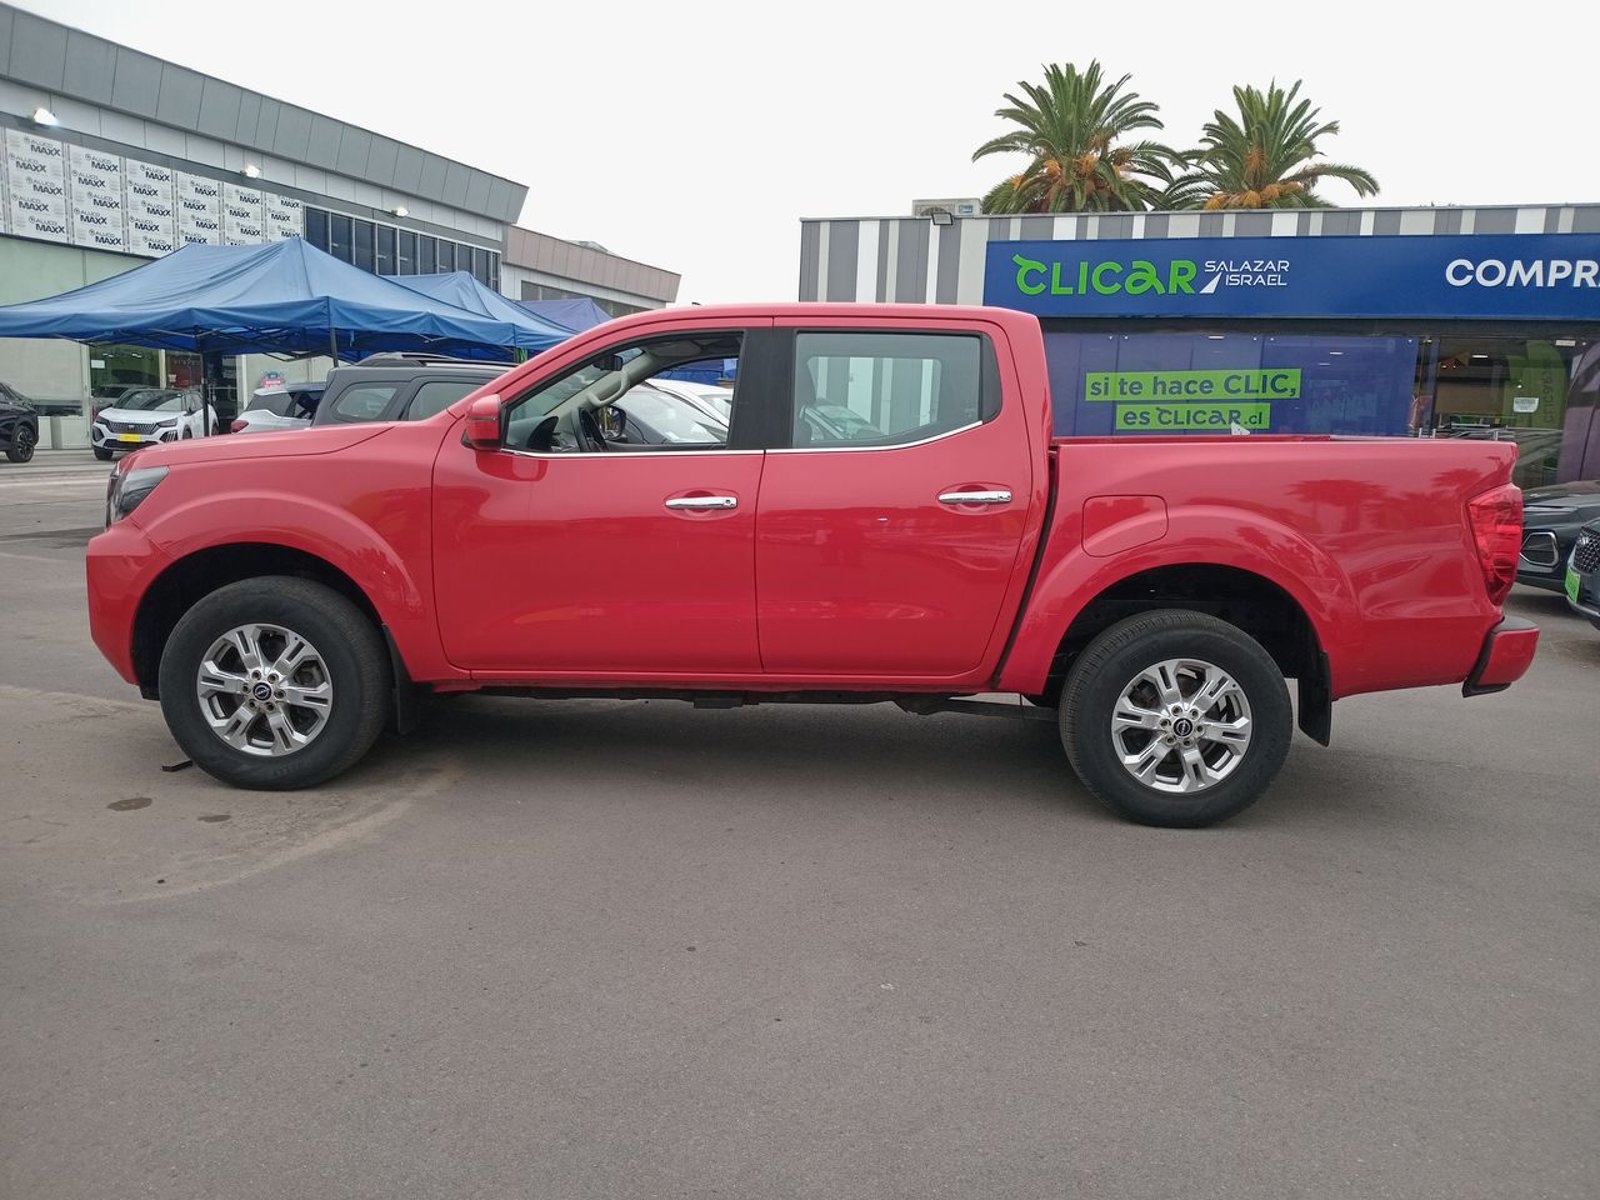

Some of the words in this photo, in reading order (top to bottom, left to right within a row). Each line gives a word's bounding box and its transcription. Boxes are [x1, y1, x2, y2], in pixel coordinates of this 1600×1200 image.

[30, 144, 61, 157] MAXX
[16, 161, 47, 173] MAXX
[91, 161, 119, 172] MAXX
[145, 171, 170, 182] MAXX
[78, 177, 106, 188] MAXX
[33, 184, 63, 196] MAXX
[133, 186, 159, 197] MAXX
[194, 187, 217, 197] MAXX
[93, 199, 120, 209] MAXX
[239, 195, 261, 205] MAXX
[280, 200, 300, 208] MAXX
[19, 201, 49, 212] MAXX
[183, 202, 207, 211] MAXX
[147, 207, 171, 217] MAXX
[229, 209, 250, 219] MAXX
[80, 215, 107, 225] MAXX
[271, 214, 291, 222] MAXX
[35, 223, 65, 234] MAXX
[134, 222, 160, 232] MAXX
[195, 221, 218, 230] MAXX
[240, 228, 261, 237] MAXX
[95, 236, 122, 245] MAXX
[148, 242, 172, 252] MAXX
[1204, 260, 1290, 272] SALAZAR
[1445, 259, 1600, 287] COMPR
[1225, 274, 1288, 286] ISRAEL
[1090, 377, 1109, 396] si
[1118, 377, 1143, 396] te
[1152, 376, 1215, 396] hace
[1223, 373, 1297, 397] CLIC,
[1123, 410, 1150, 426] es
